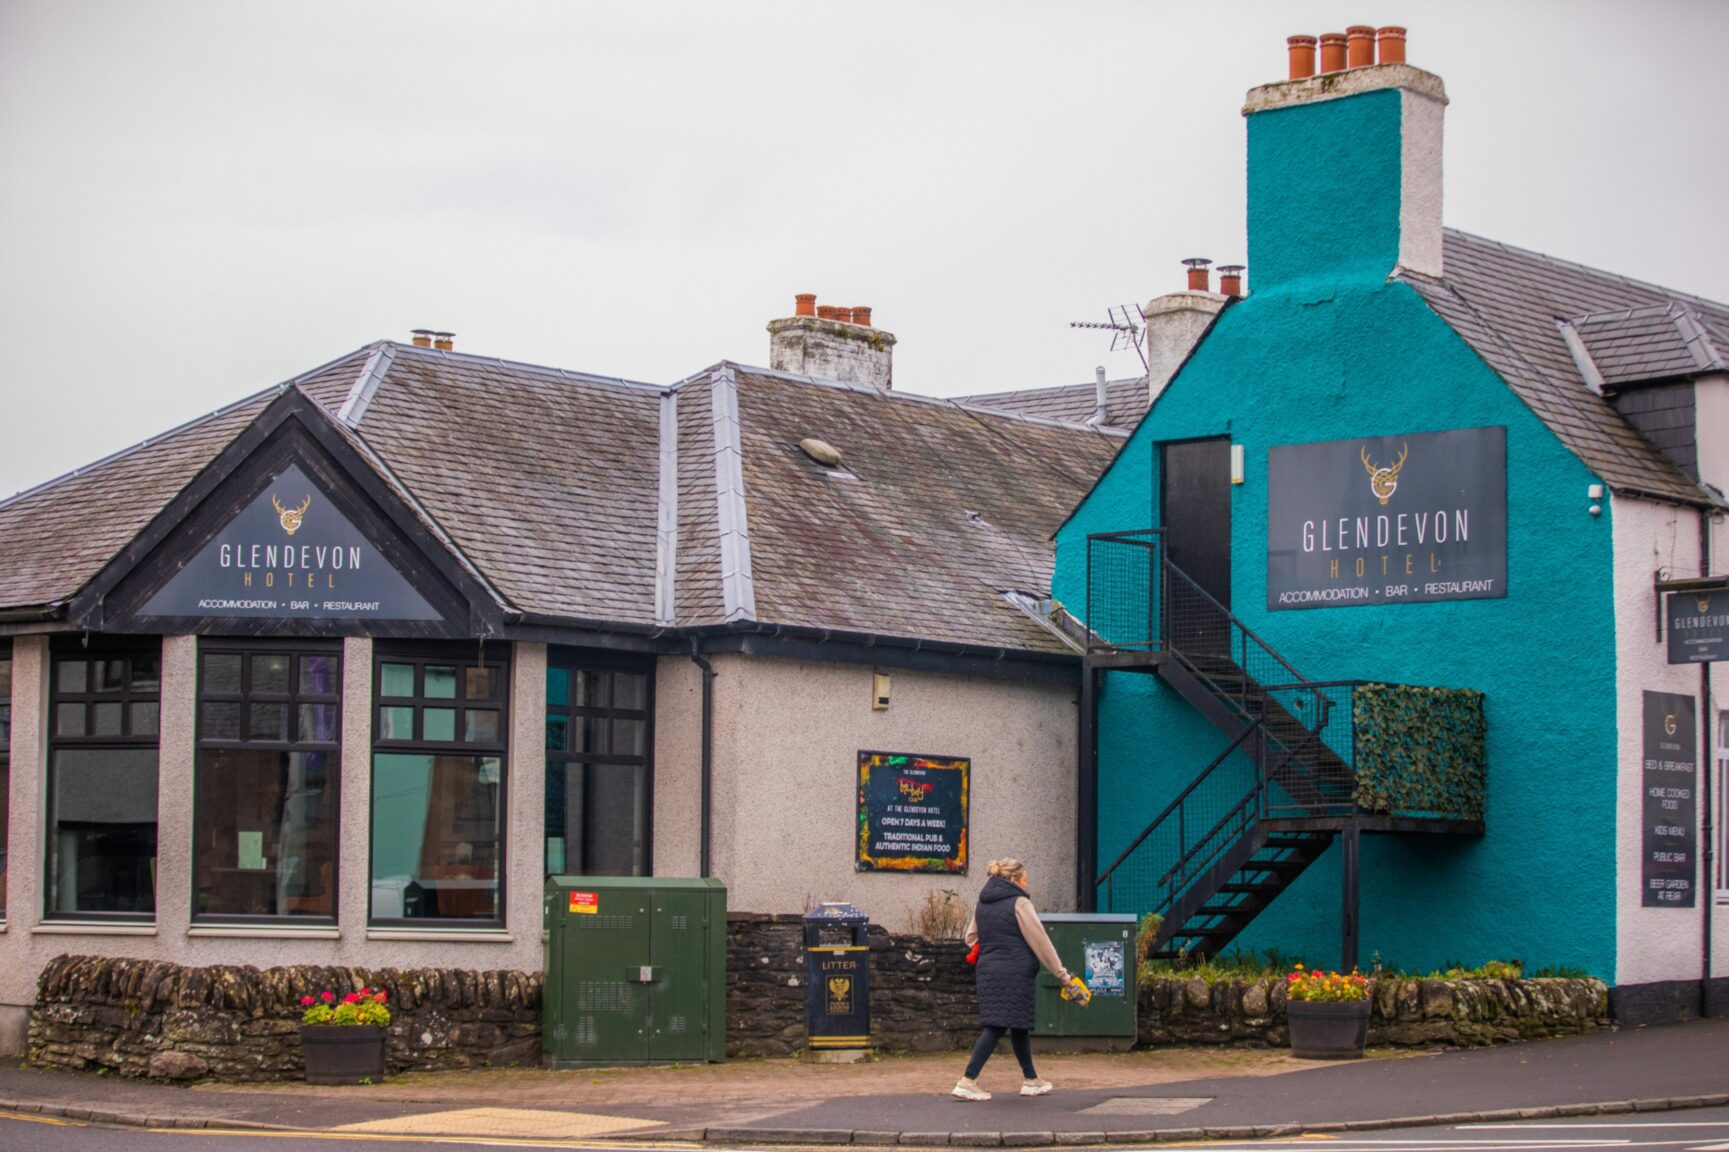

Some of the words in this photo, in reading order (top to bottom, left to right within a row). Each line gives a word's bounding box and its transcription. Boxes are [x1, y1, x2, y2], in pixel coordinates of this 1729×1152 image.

[1302, 509, 1469, 553] GLENDEVON
[219, 543, 361, 570] GLENDEVON
[1330, 552, 1438, 578] HOTEL
[244, 572, 336, 589] HOTEL
[1278, 586, 1369, 604] ACCOMMODATION
[1385, 584, 1408, 598] BAR
[1424, 578, 1494, 596] RESTAURANT
[198, 599, 277, 610] ACCOMMODATION
[290, 600, 310, 611] BAR
[322, 600, 381, 612] RESTAURANT
[1645, 759, 1657, 770] BED
[1658, 760, 1663, 770] &
[1664, 761, 1694, 772] BREAKFAST
[1649, 787, 1666, 798] HOME
[1666, 788, 1690, 799] COOKED
[1661, 799, 1678, 810] FOOD
[881, 817, 900, 826] OPEN
[900, 818, 904, 826] 7
[905, 818, 921, 827] DAYS
[921, 819, 926, 827] A
[927, 819, 946, 828] WEEK!
[883, 832, 924, 842] TRADITIONAL
[925, 833, 938, 842] PUB
[938, 834, 943, 842] &
[1654, 825, 1668, 835] KIDS
[1668, 826, 1686, 837] MENU
[875, 841, 911, 851] AUTHENTIC
[911, 843, 933, 852] INDIAN
[933, 843, 951, 852] FOOD
[1653, 851, 1673, 862] PUBLIC
[1673, 852, 1686, 863] BAR
[1649, 878, 1665, 889] BEER
[1665, 879, 1689, 890] GARDEN
[1657, 891, 1664, 900] AT
[1665, 891, 1682, 901] REAR
[822, 961, 857, 970] LITTER
